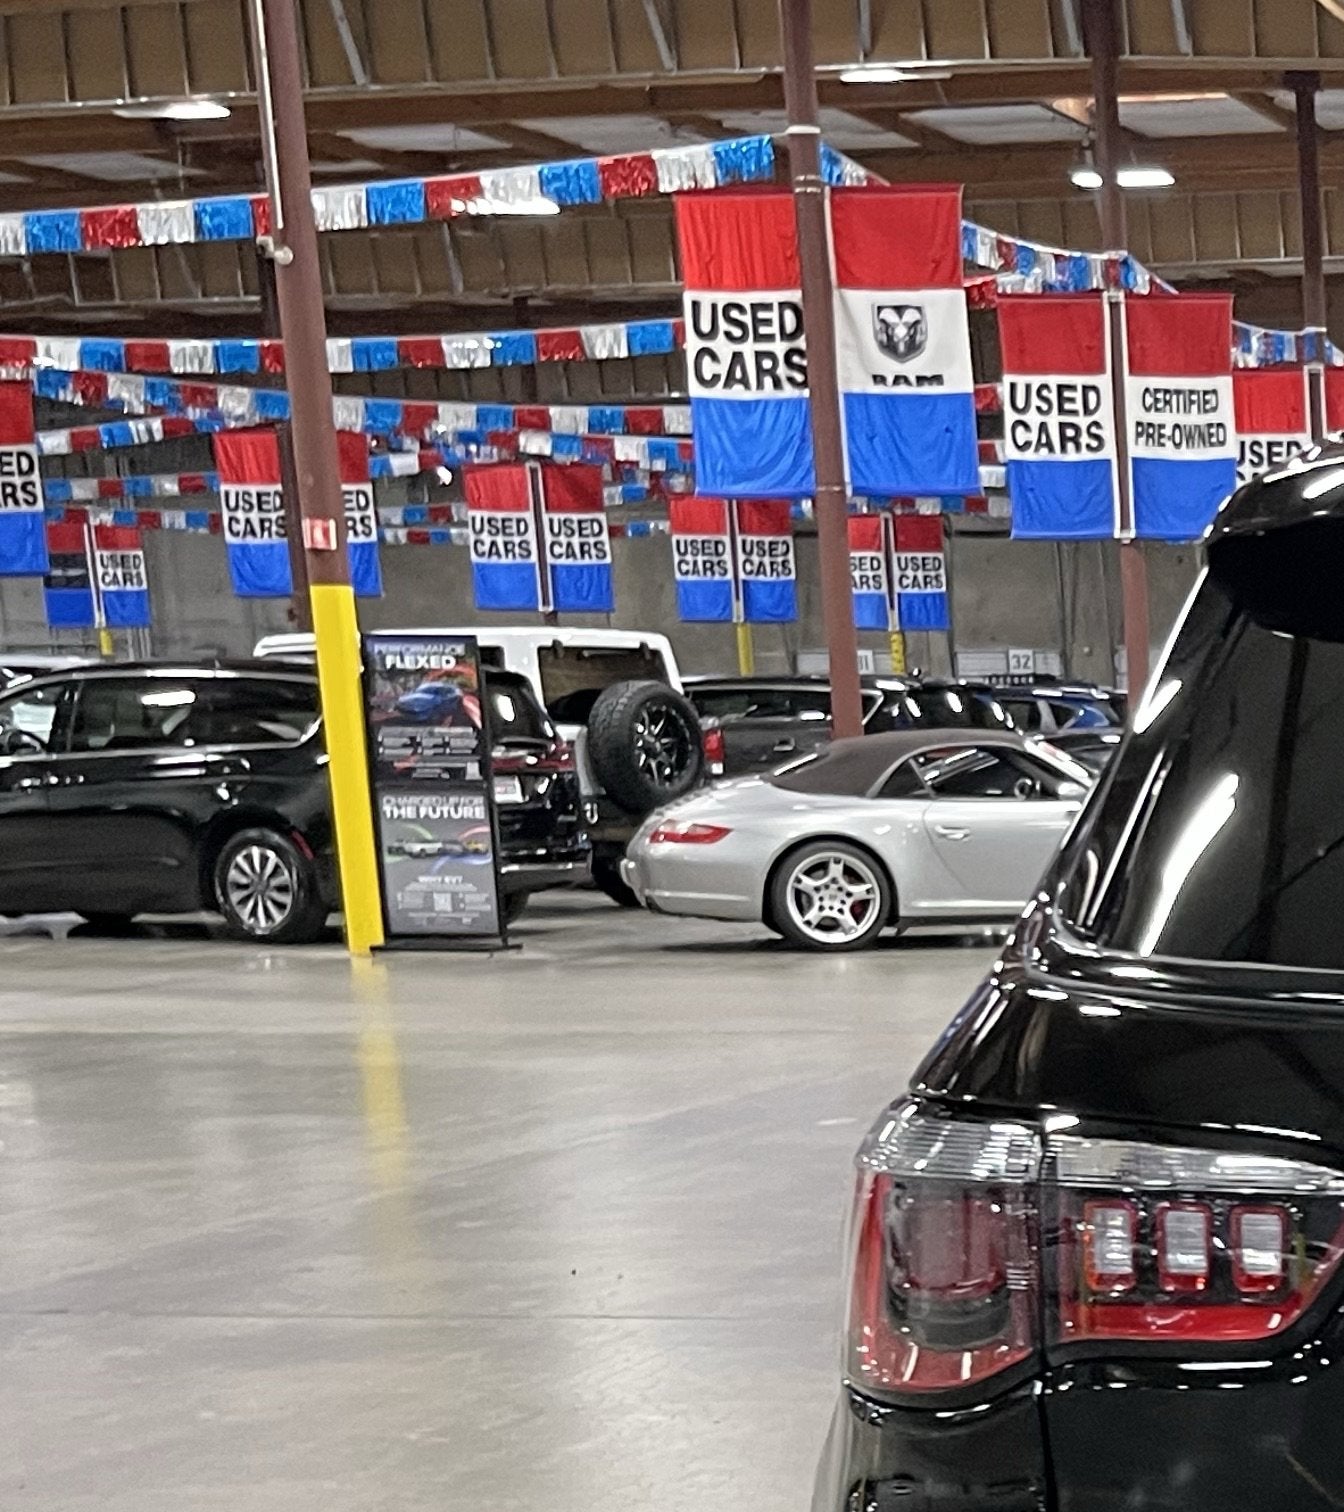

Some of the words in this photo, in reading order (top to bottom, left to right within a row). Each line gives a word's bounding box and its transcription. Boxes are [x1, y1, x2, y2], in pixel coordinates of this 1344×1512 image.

[691, 300, 805, 344] USED
[693, 346, 809, 391] CARS
[871, 373, 945, 388] RAM
[1009, 381, 1101, 417] USED
[1141, 387, 1220, 414] CERTIFIED
[1010, 419, 1105, 455] CARS
[1134, 421, 1227, 450] PRE-OWNED
[0, 451, 36, 478] ED
[0, 481, 38, 508] RS
[224, 489, 283, 512] USED
[343, 489, 370, 512] ED
[227, 515, 287, 539] CARS
[346, 514, 373, 538] RS
[470, 516, 530, 537] USED
[548, 517, 604, 538] USED
[473, 539, 532, 560] CARS
[549, 540, 608, 561] CARS
[675, 538, 727, 557] USED
[741, 538, 791, 558] USED
[99, 553, 143, 569] USED
[676, 559, 729, 577] CARS
[741, 558, 793, 577] CARS
[849, 555, 881, 572] SED
[897, 555, 943, 572] USED
[101, 570, 144, 587] CARS
[898, 573, 944, 590] CARS
[384, 654, 457, 671] FLEXED
[1012, 654, 1032, 670] 32
[382, 805, 417, 819] THE
[419, 805, 485, 819] FUTURE
